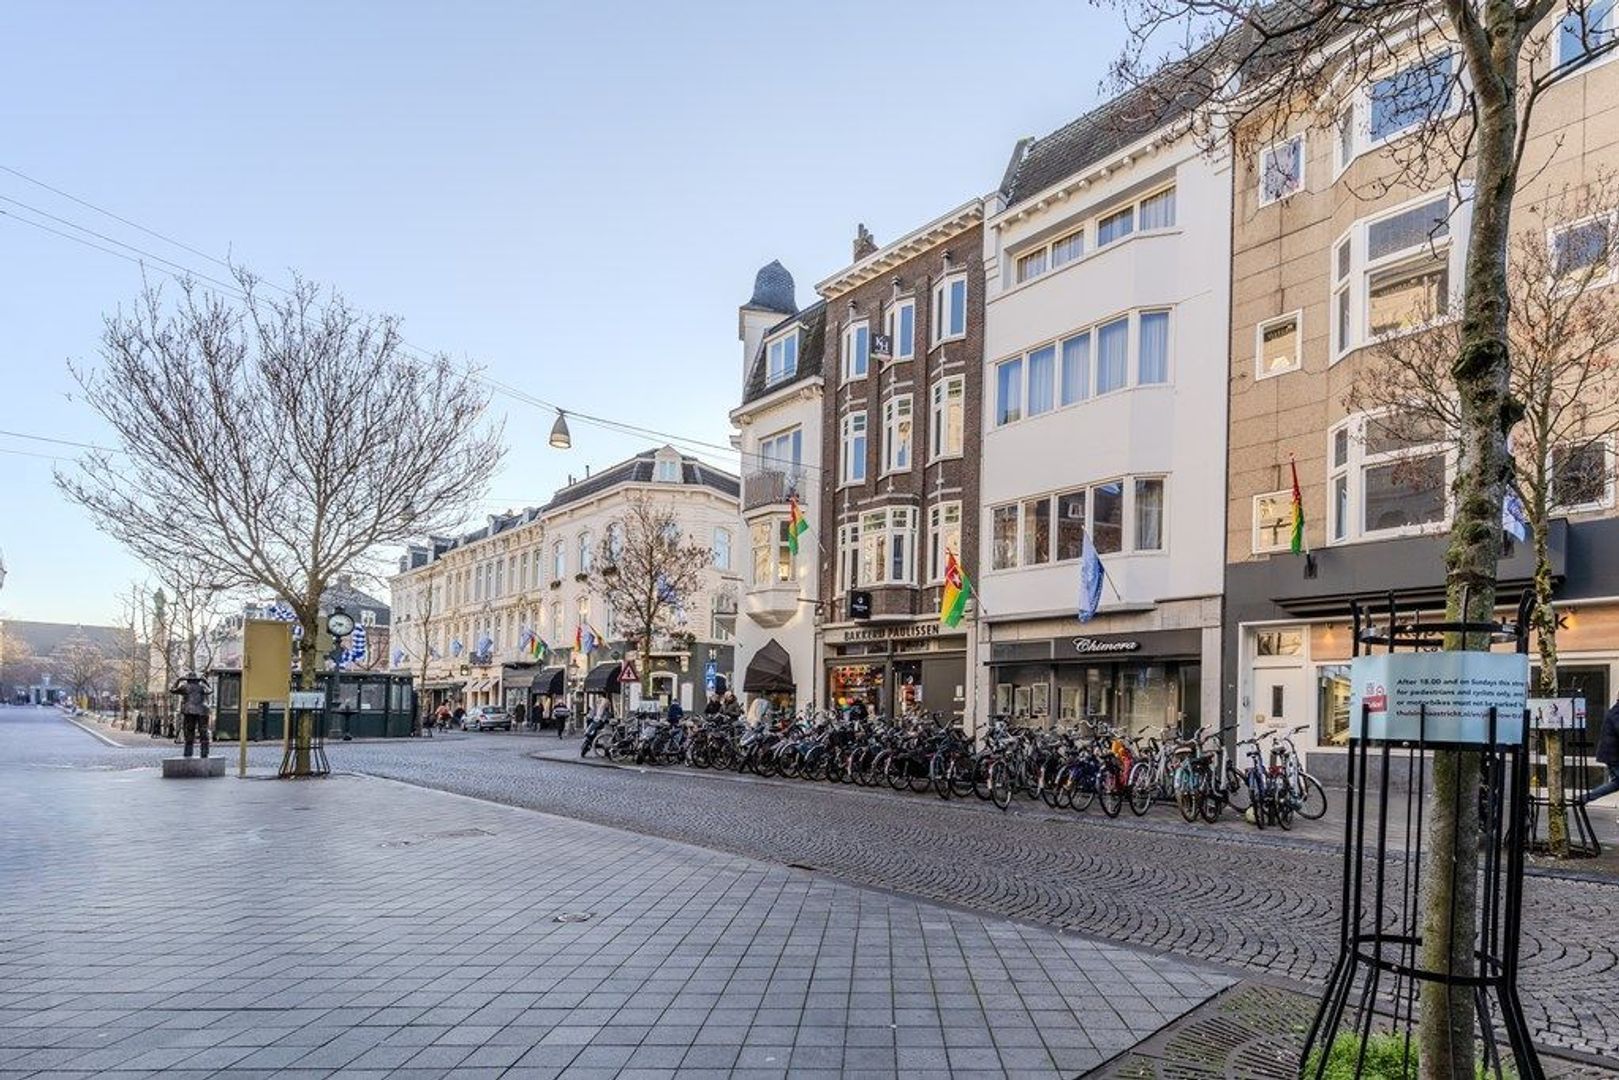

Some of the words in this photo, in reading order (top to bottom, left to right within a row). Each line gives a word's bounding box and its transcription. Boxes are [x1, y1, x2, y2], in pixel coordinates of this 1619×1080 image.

[887, 623, 940, 638] PAULISSEN
[1072, 637, 1138, 653] Chimera
[1471, 679, 1497, 688] Sundays
[1410, 689, 1455, 697] pedestrians
[1406, 699, 1451, 707] motorbikes
